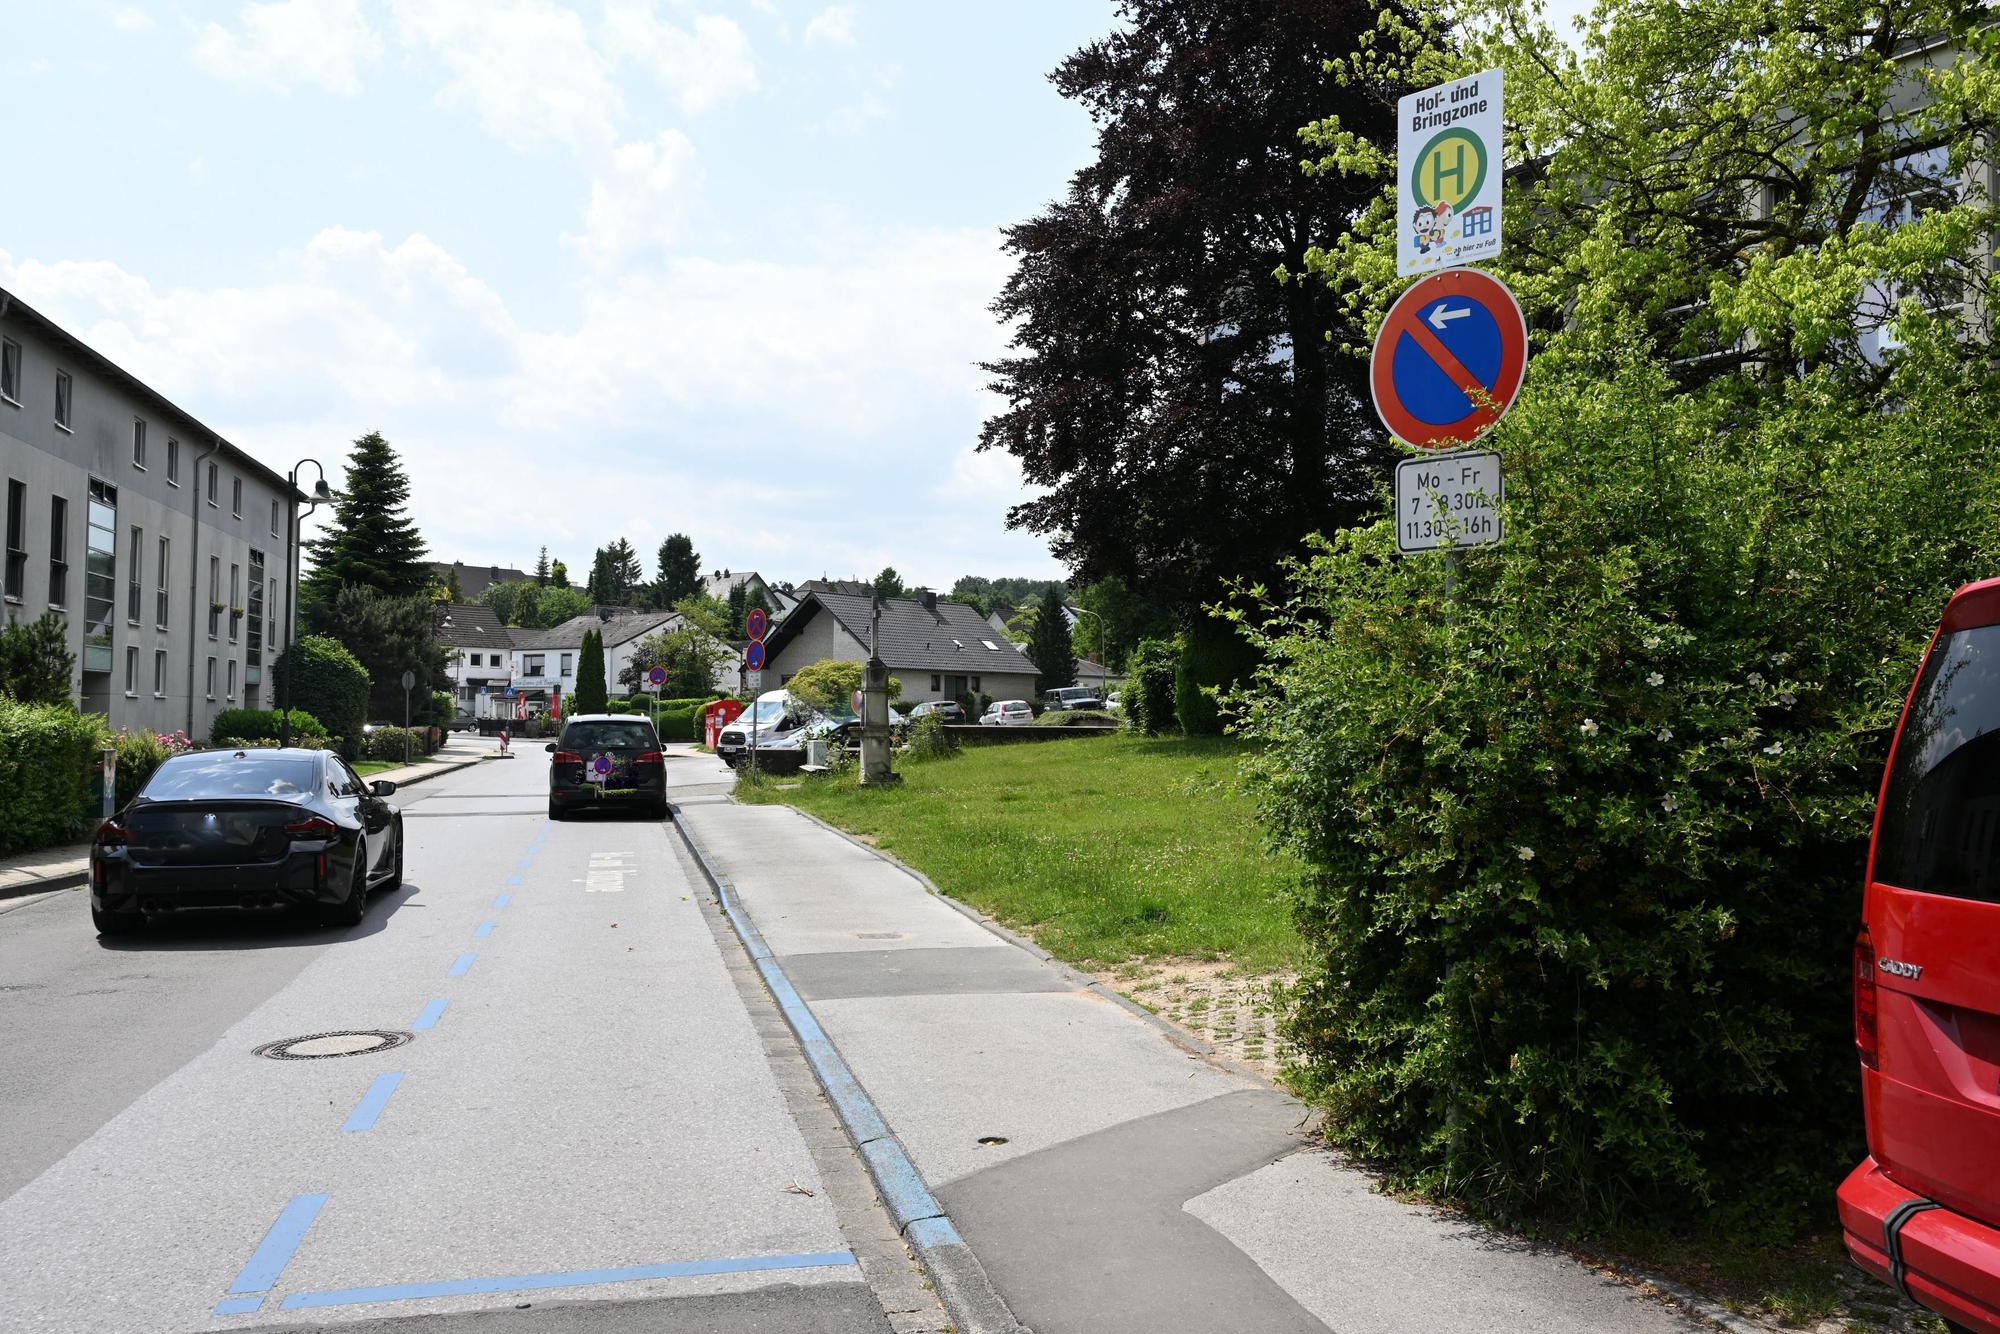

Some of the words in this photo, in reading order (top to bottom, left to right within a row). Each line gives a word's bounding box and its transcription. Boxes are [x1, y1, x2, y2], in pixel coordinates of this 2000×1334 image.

[1416, 91, 1445, 114] Hol-
[1451, 81, 1478, 103] und
[1413, 99, 1487, 132] Bringzone
[1433, 144, 1464, 201] H
[1463, 243, 1475, 251] hier
[1485, 238, 1497, 247] Fuß
[1417, 472, 1440, 490] Mo
[1462, 467, 1480, 485] Fr
[1412, 497, 1420, 515] 7
[1407, 520, 1442, 539] 11.30
[1463, 516, 1491, 534] 16h
[1878, 957, 1923, 980] CADDY
